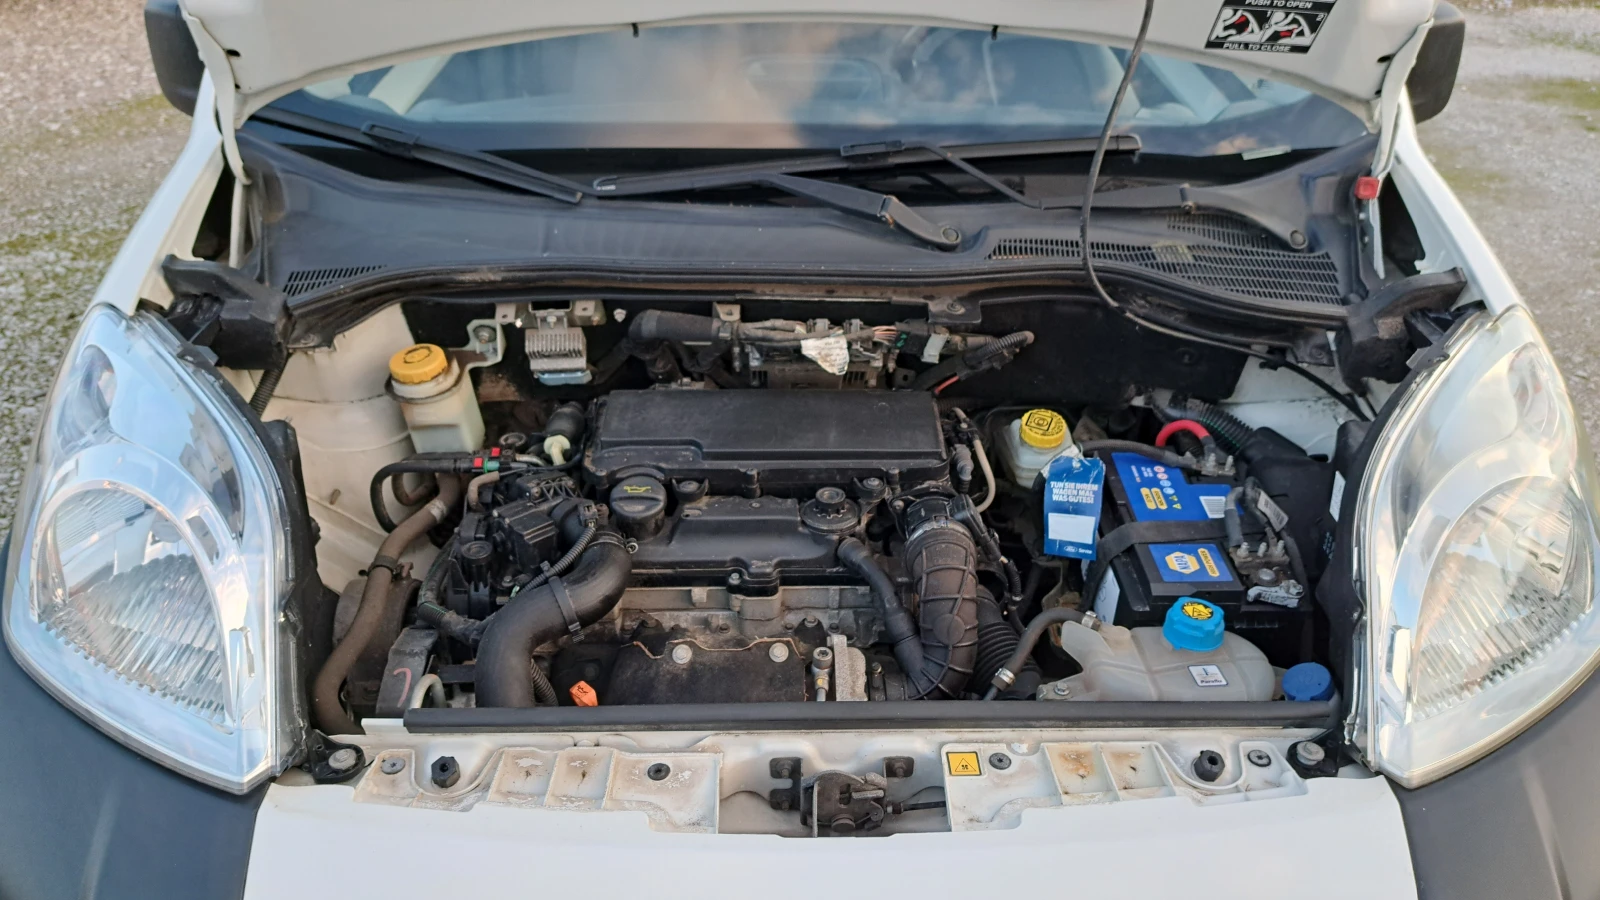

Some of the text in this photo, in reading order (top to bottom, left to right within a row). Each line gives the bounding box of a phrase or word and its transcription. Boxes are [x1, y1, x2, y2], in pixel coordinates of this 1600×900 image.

[1286, 1, 1313, 9] OPEN
[1223, 43, 1245, 51] PULL
[1050, 481, 1064, 489] TUN
[1076, 483, 1098, 491] IHREM
[1053, 488, 1077, 496] WAGEN
[1052, 494, 1067, 502] WAS
[1173, 555, 1192, 570] NAPA
